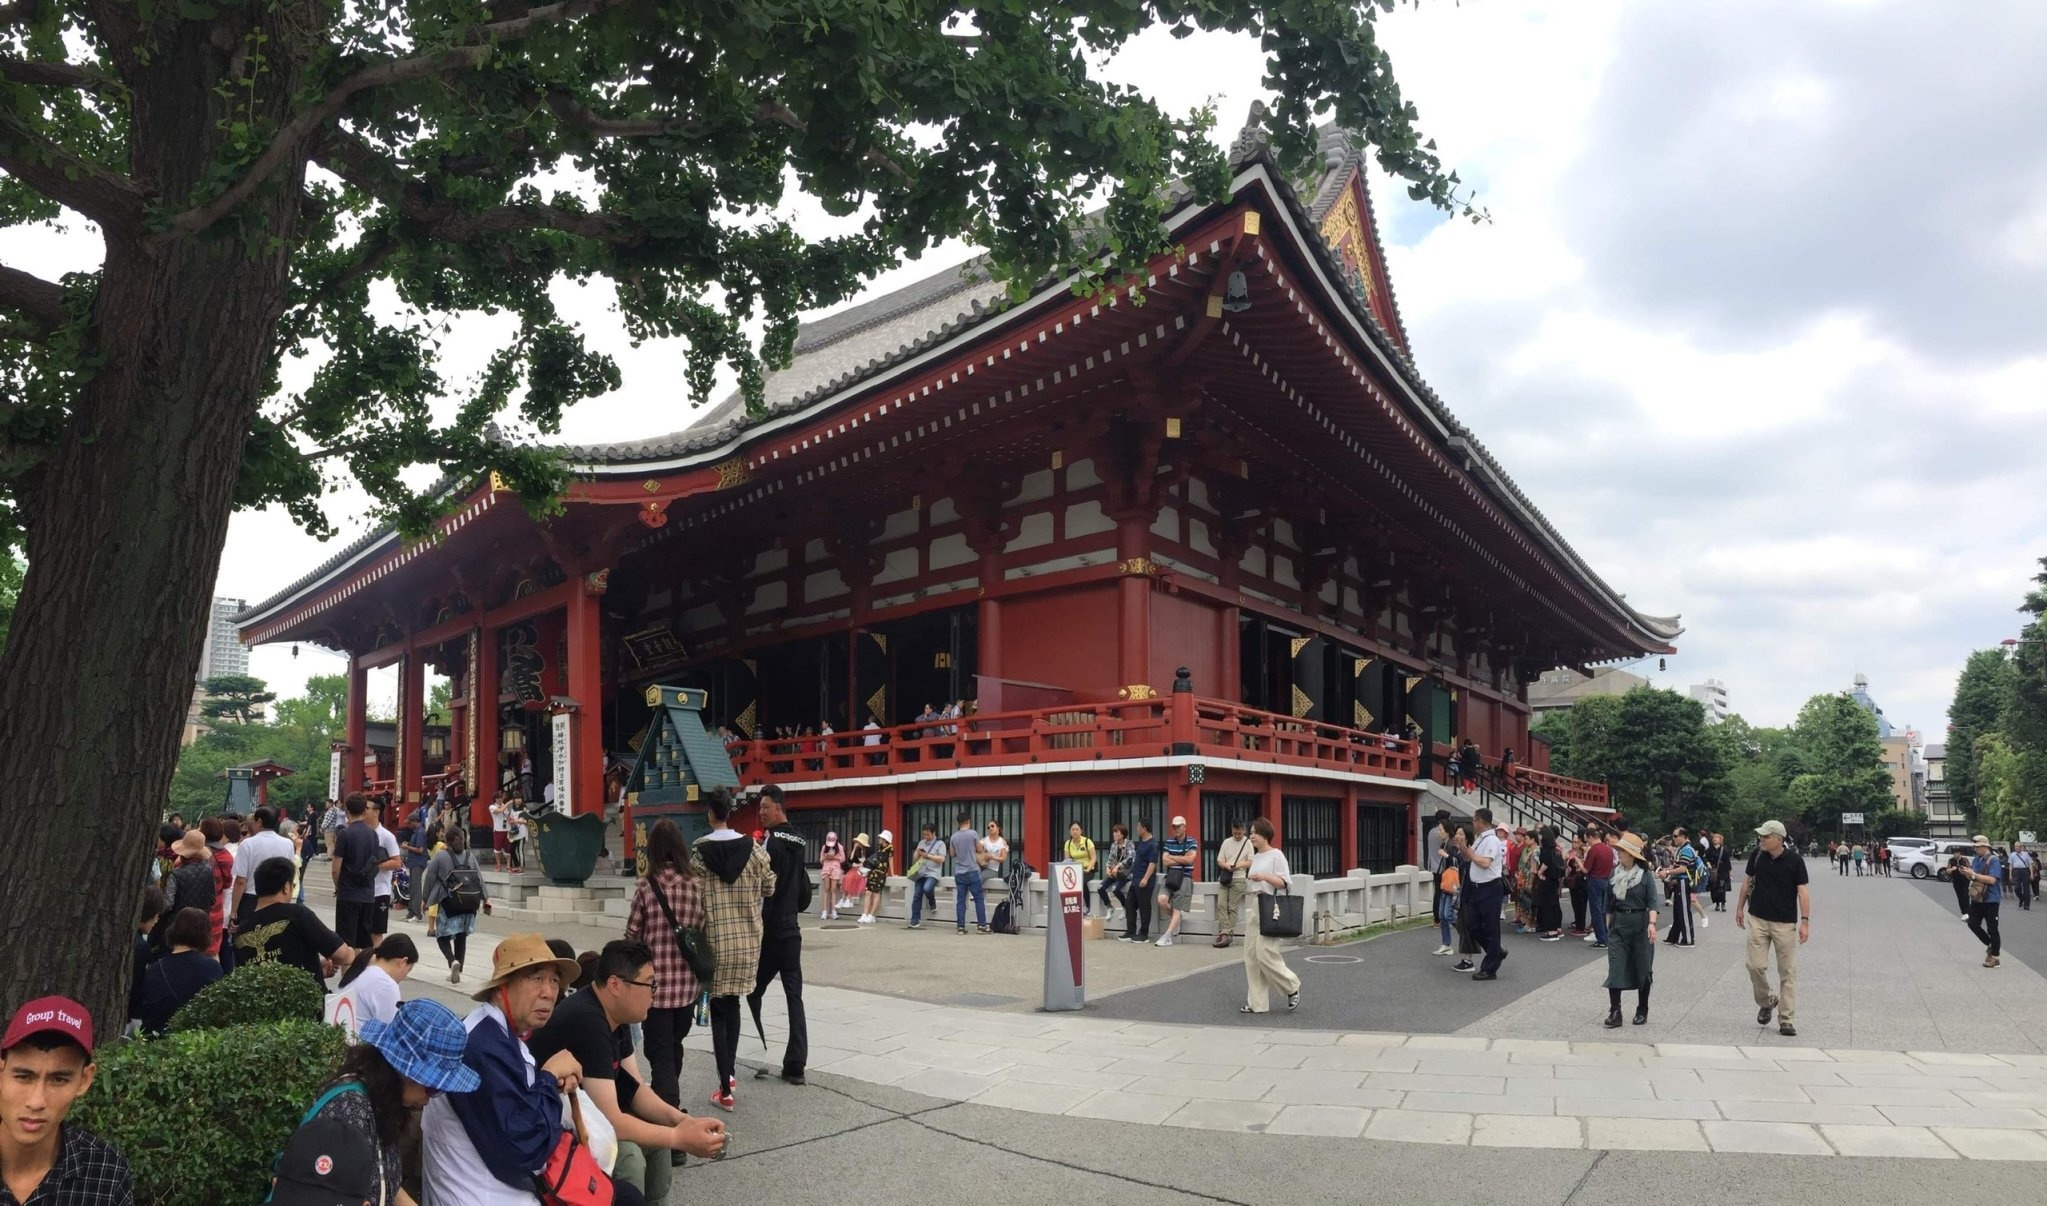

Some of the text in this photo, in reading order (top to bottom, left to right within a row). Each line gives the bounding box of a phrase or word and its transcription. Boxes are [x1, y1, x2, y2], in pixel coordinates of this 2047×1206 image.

[267, 947, 283, 958] THE
[26, 1009, 82, 1030] Group travel
